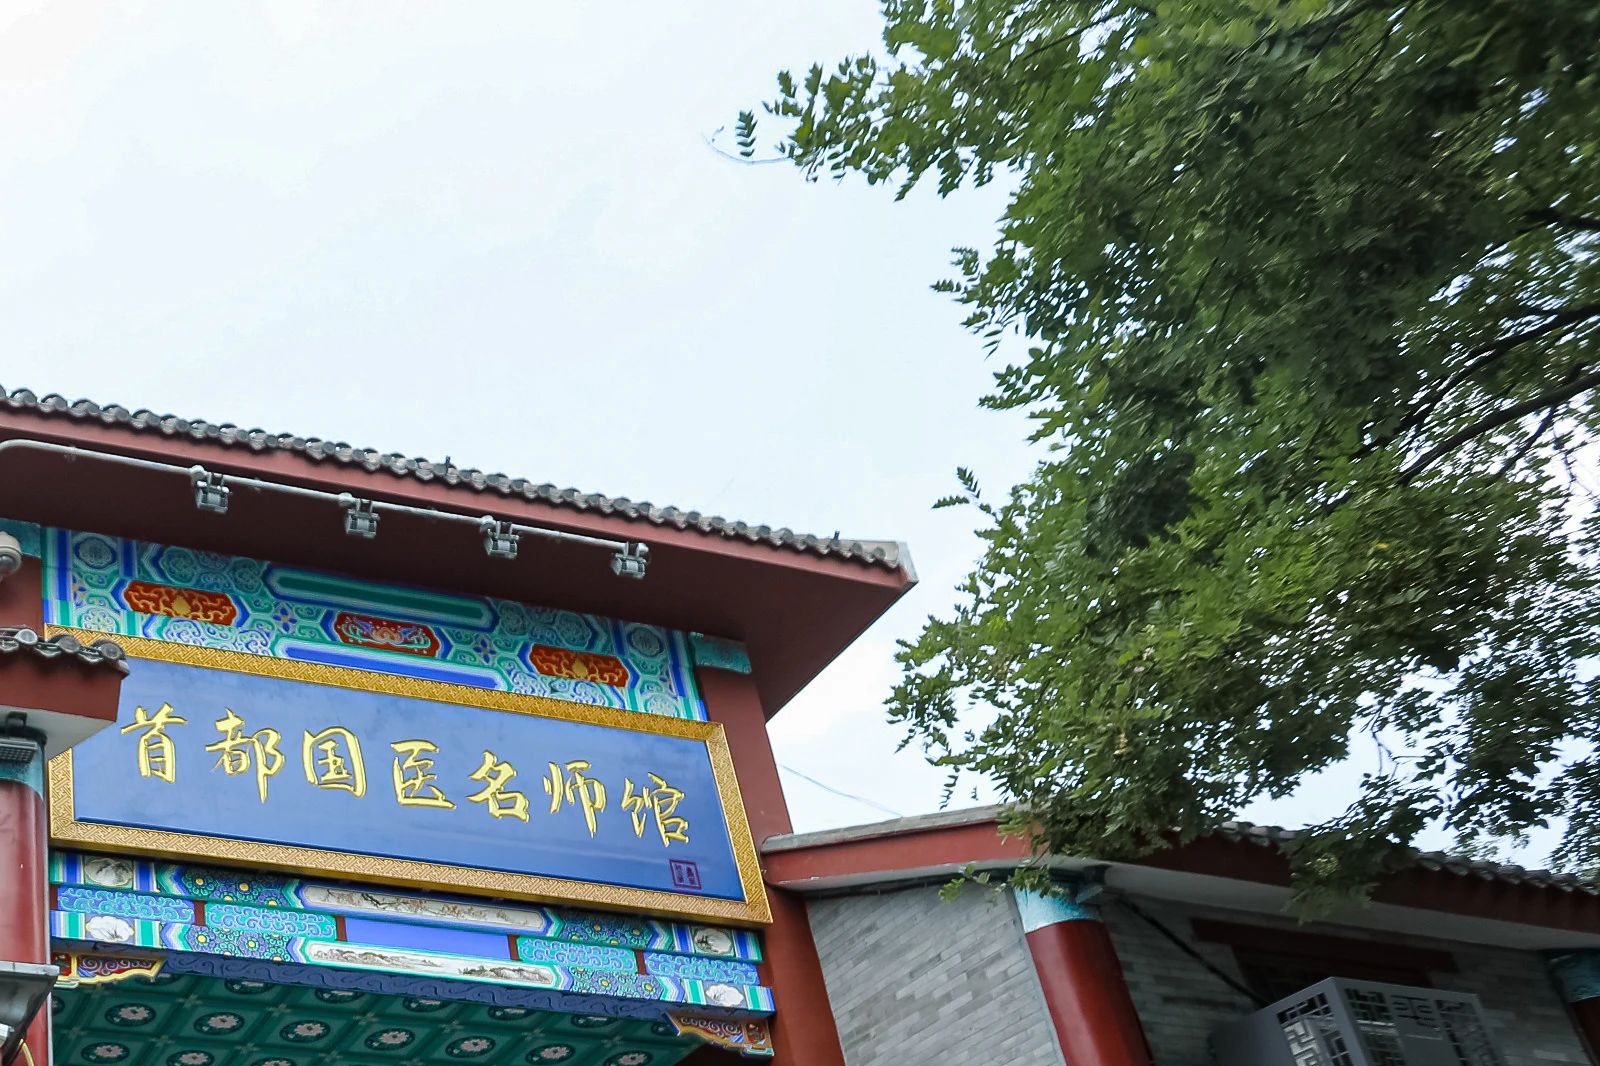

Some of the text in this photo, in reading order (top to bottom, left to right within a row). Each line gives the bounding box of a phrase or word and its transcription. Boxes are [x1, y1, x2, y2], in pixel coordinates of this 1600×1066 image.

[120, 703, 692, 847] 首都国医名师馆
